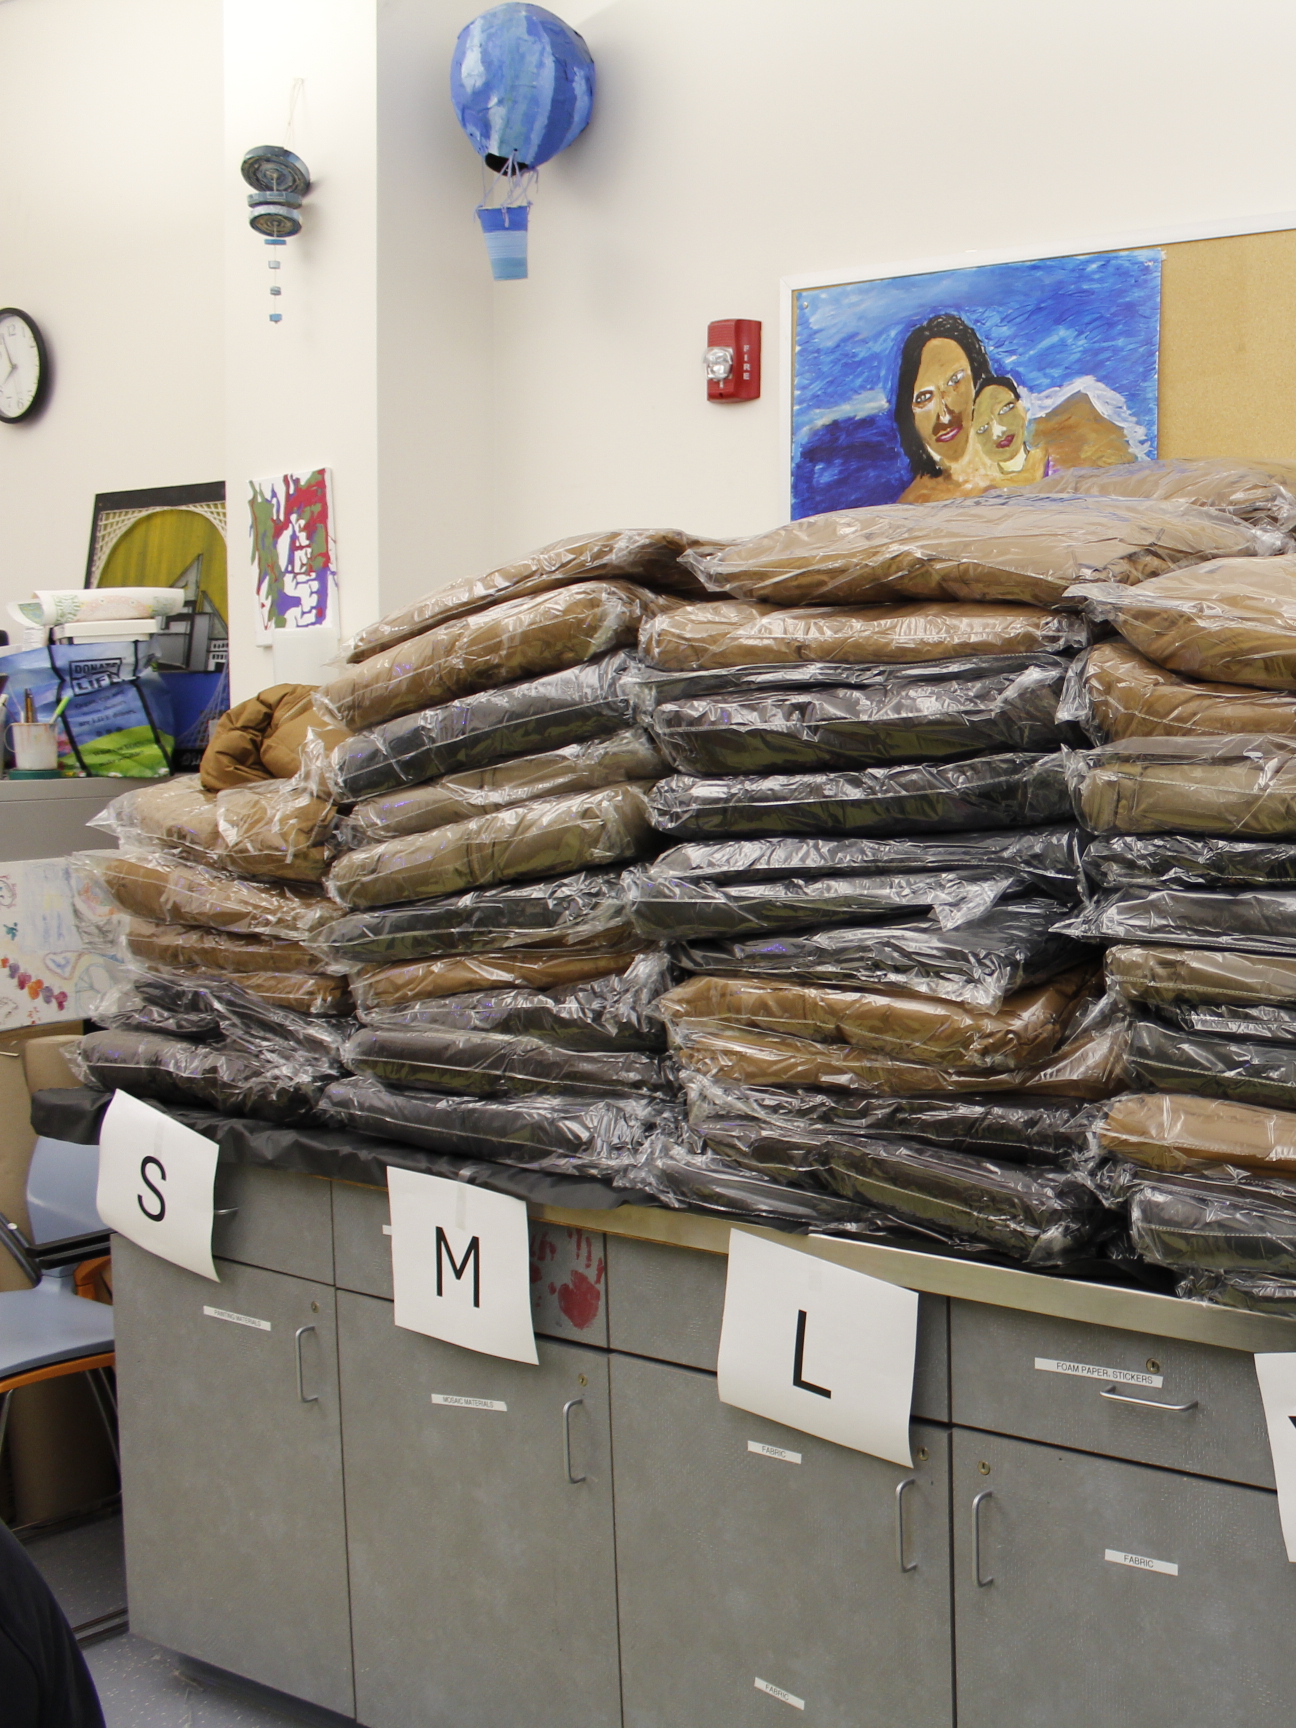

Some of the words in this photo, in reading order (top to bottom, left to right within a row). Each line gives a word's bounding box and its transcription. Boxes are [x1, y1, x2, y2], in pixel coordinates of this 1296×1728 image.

[743, 345, 751, 380] FIRE
[137, 1155, 167, 1222] S
[435, 1225, 480, 1308] M
[792, 1309, 831, 1399] L
[1057, 1362, 1080, 1373] FOAM
[1112, 1370, 1153, 1385] STICKERS
[442, 1396, 463, 1405] MOSAIC
[464, 1398, 494, 1409] MATERIALS
[761, 1445, 787, 1459] FABRIC
[1123, 1554, 1154, 1569] FABRIC
[765, 1683, 789, 1701] FABRIC
